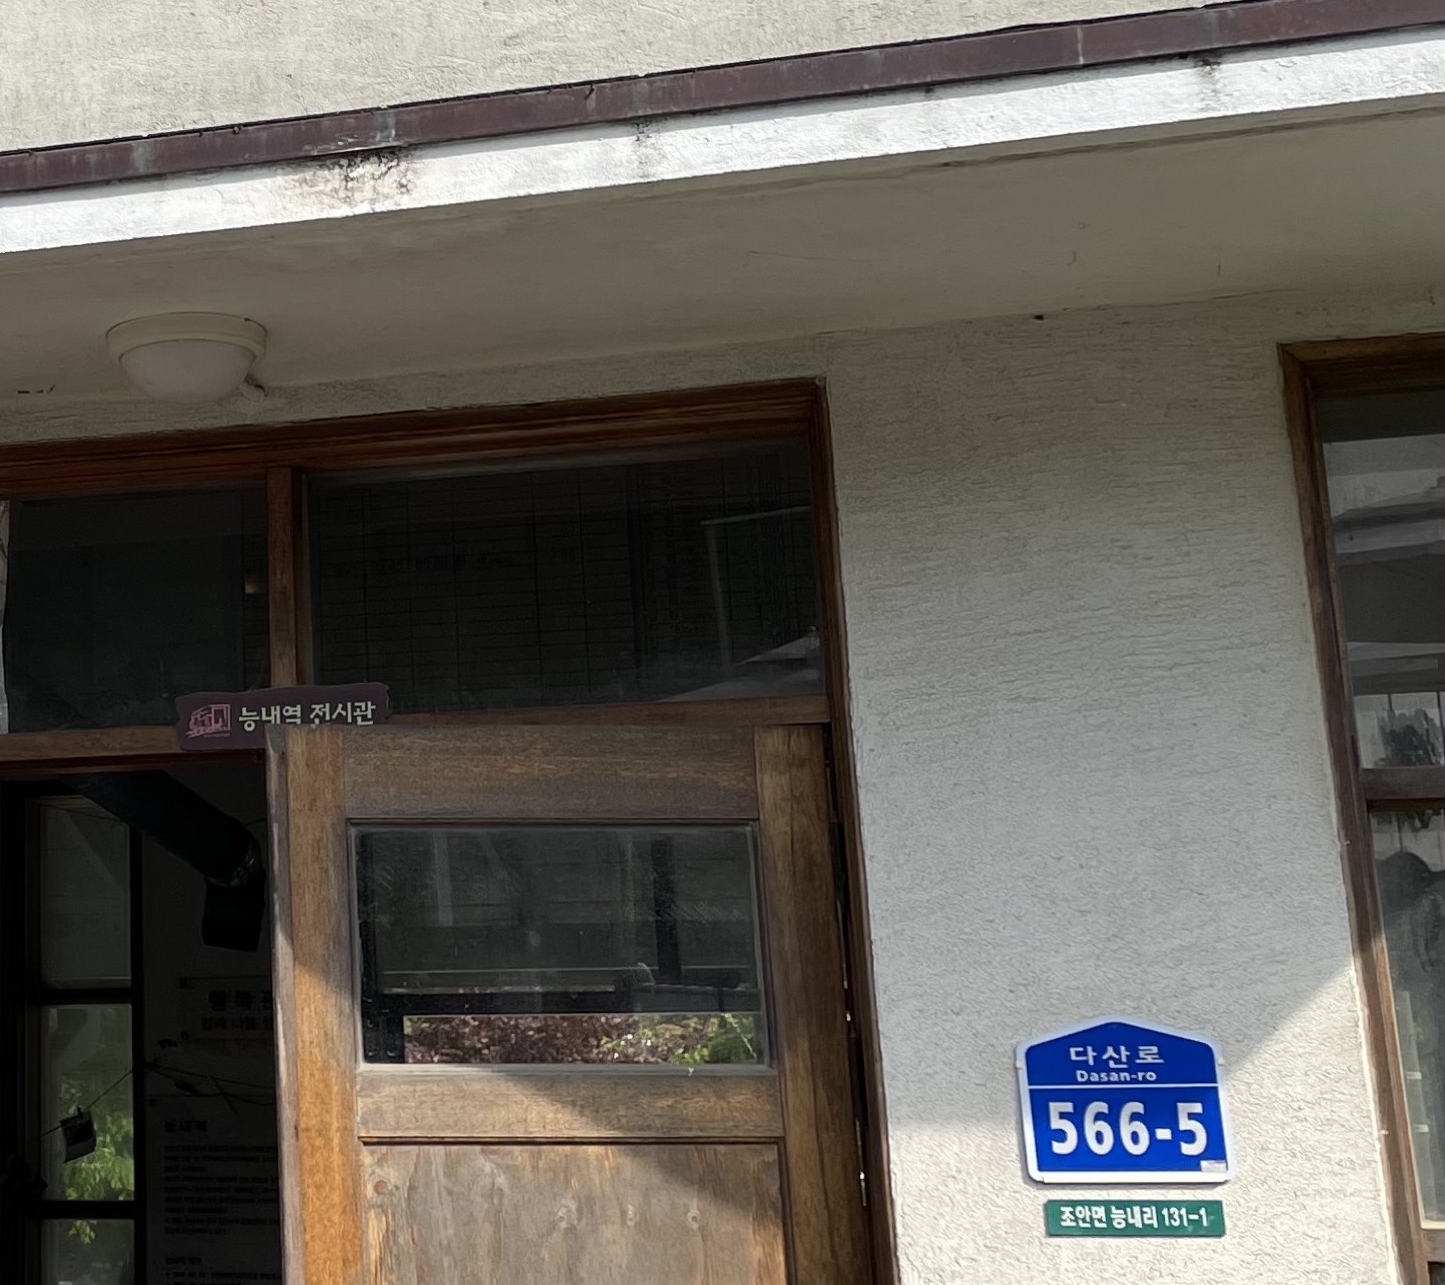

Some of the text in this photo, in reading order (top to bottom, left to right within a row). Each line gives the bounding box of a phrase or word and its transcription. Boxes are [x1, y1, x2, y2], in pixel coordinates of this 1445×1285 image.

[239, 701, 376, 732] 능내역 전시관
[1069, 1045, 1165, 1068] 다산로
[1076, 1070, 1157, 1082] Dasan-ro
[1048, 1101, 1208, 1156] 566-5
[1060, 1206, 1208, 1229] 조안면 능내리 131-1
